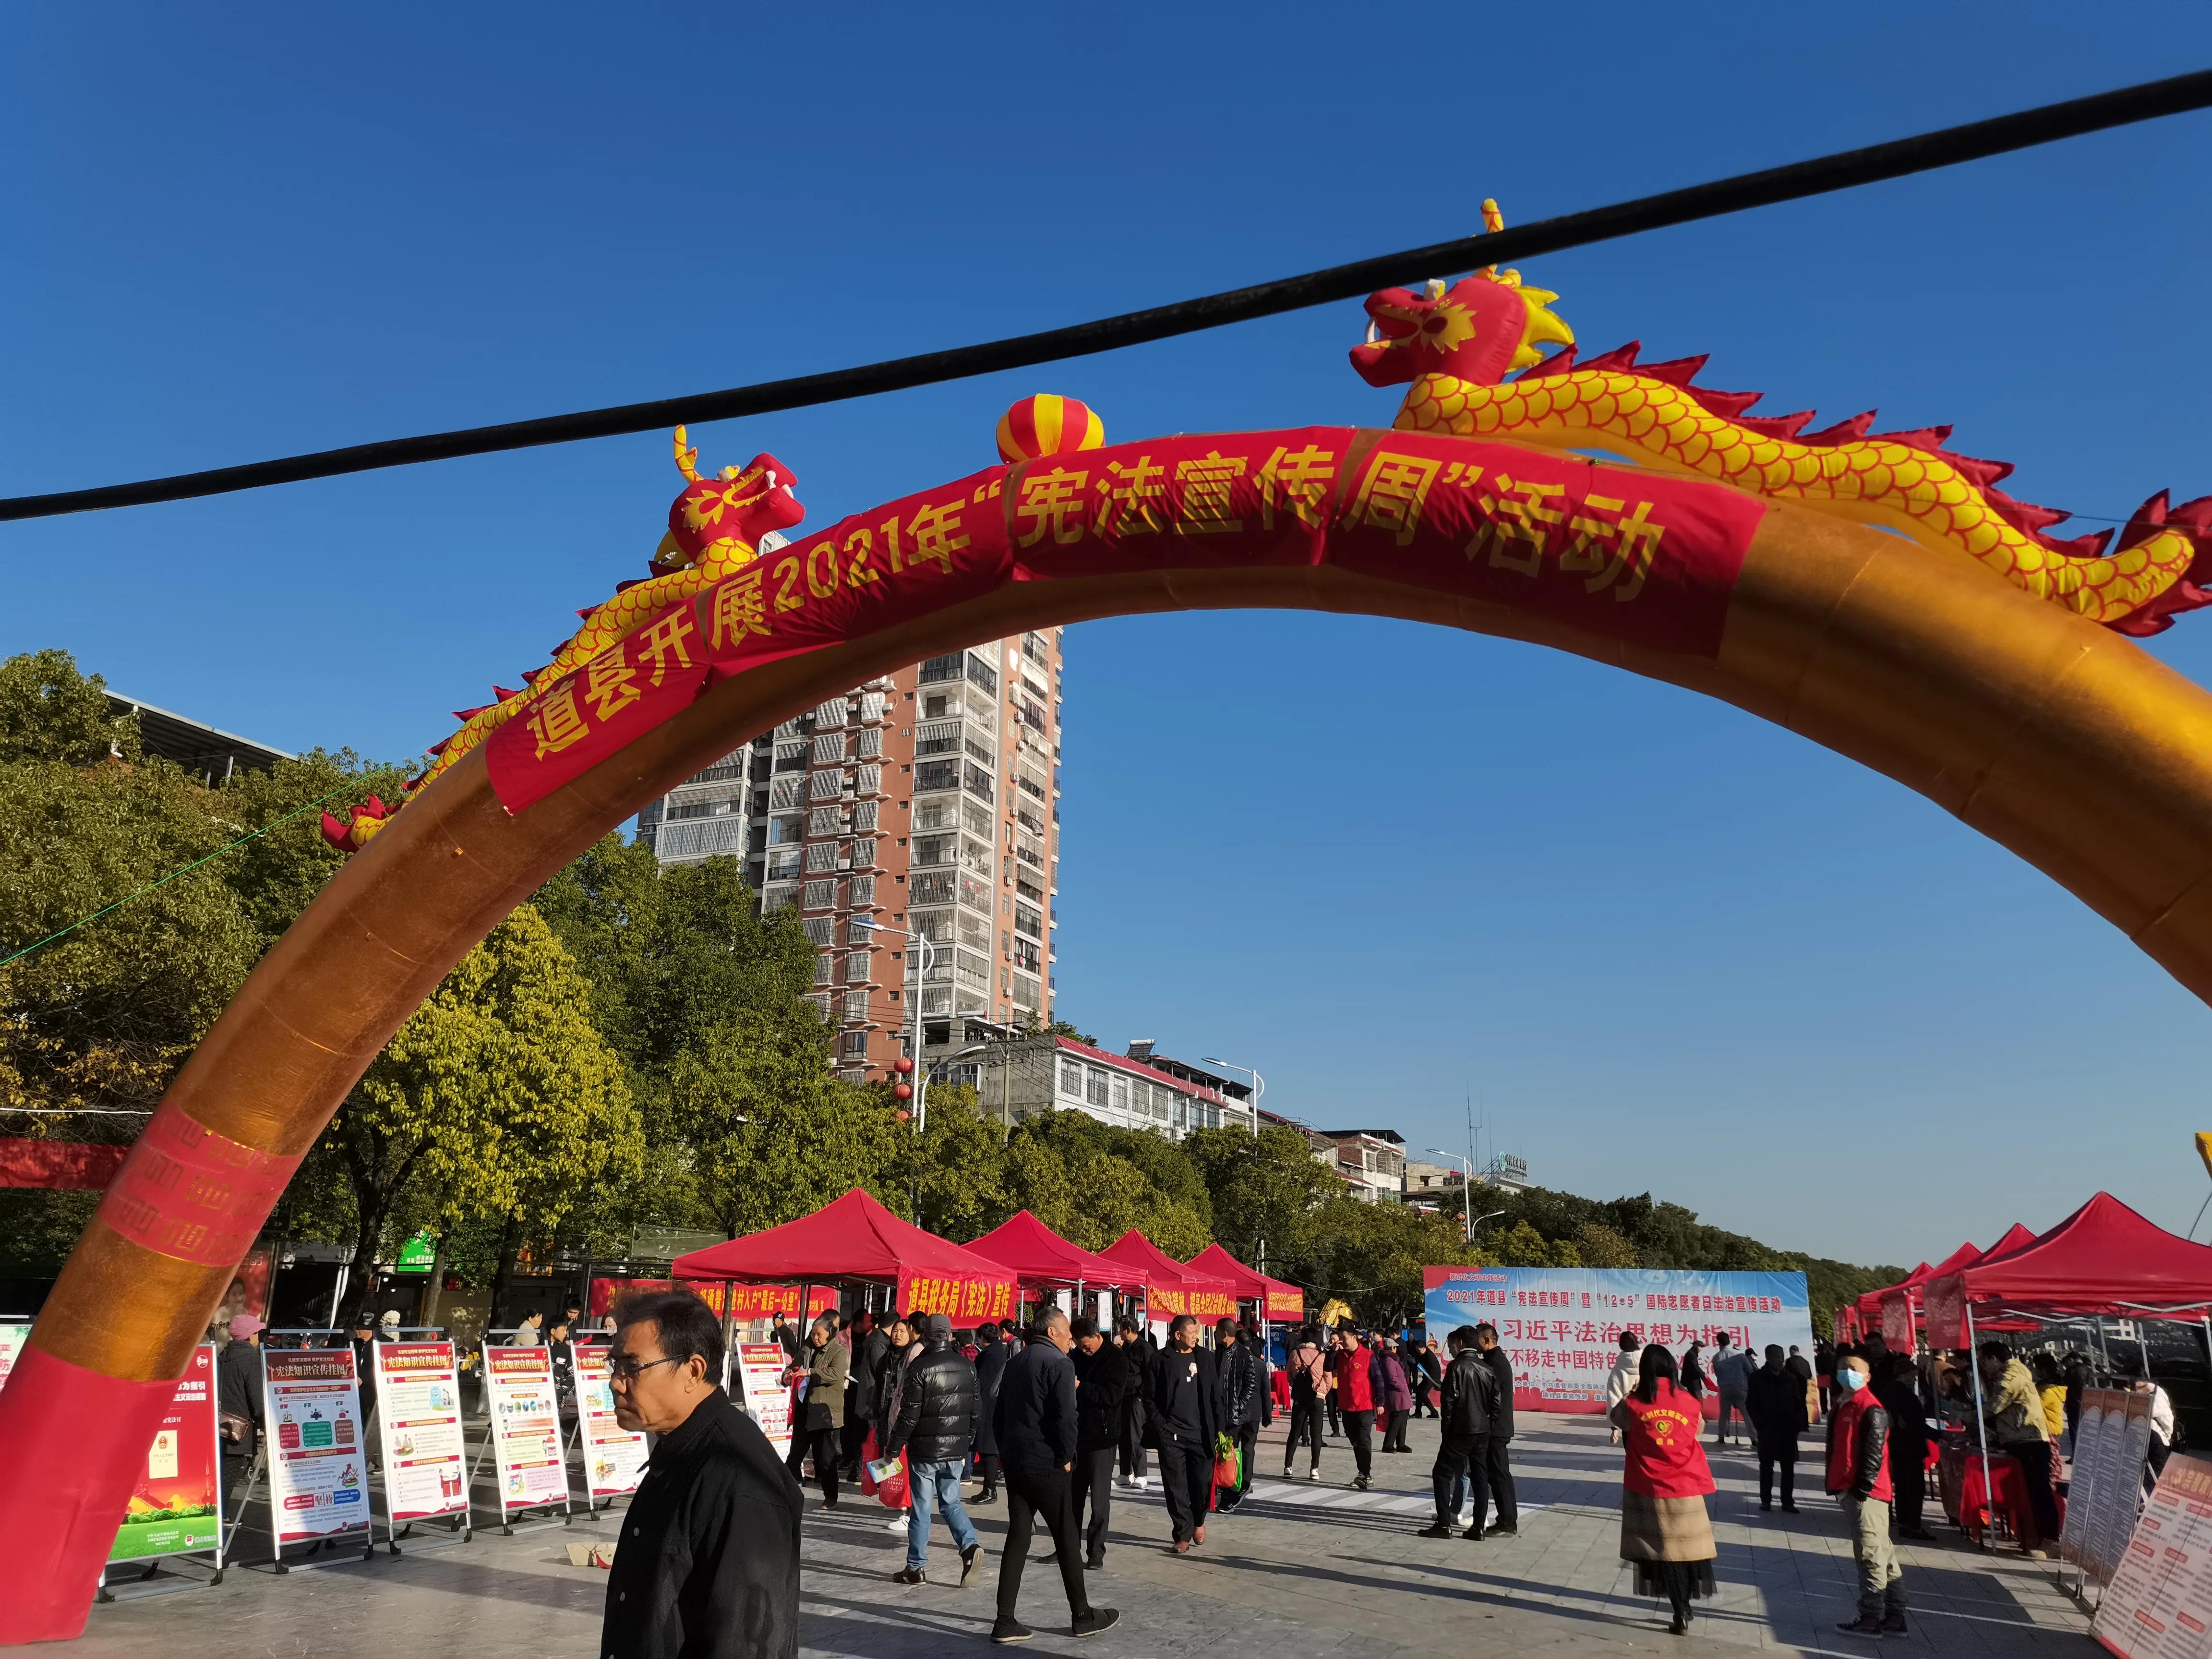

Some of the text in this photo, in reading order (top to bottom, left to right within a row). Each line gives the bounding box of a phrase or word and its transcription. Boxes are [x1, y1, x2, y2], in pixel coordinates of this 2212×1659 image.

[276, 1364, 346, 1377] 宪法知识宣传挂图
[173, 1393, 206, 1401] 主义法治道路
